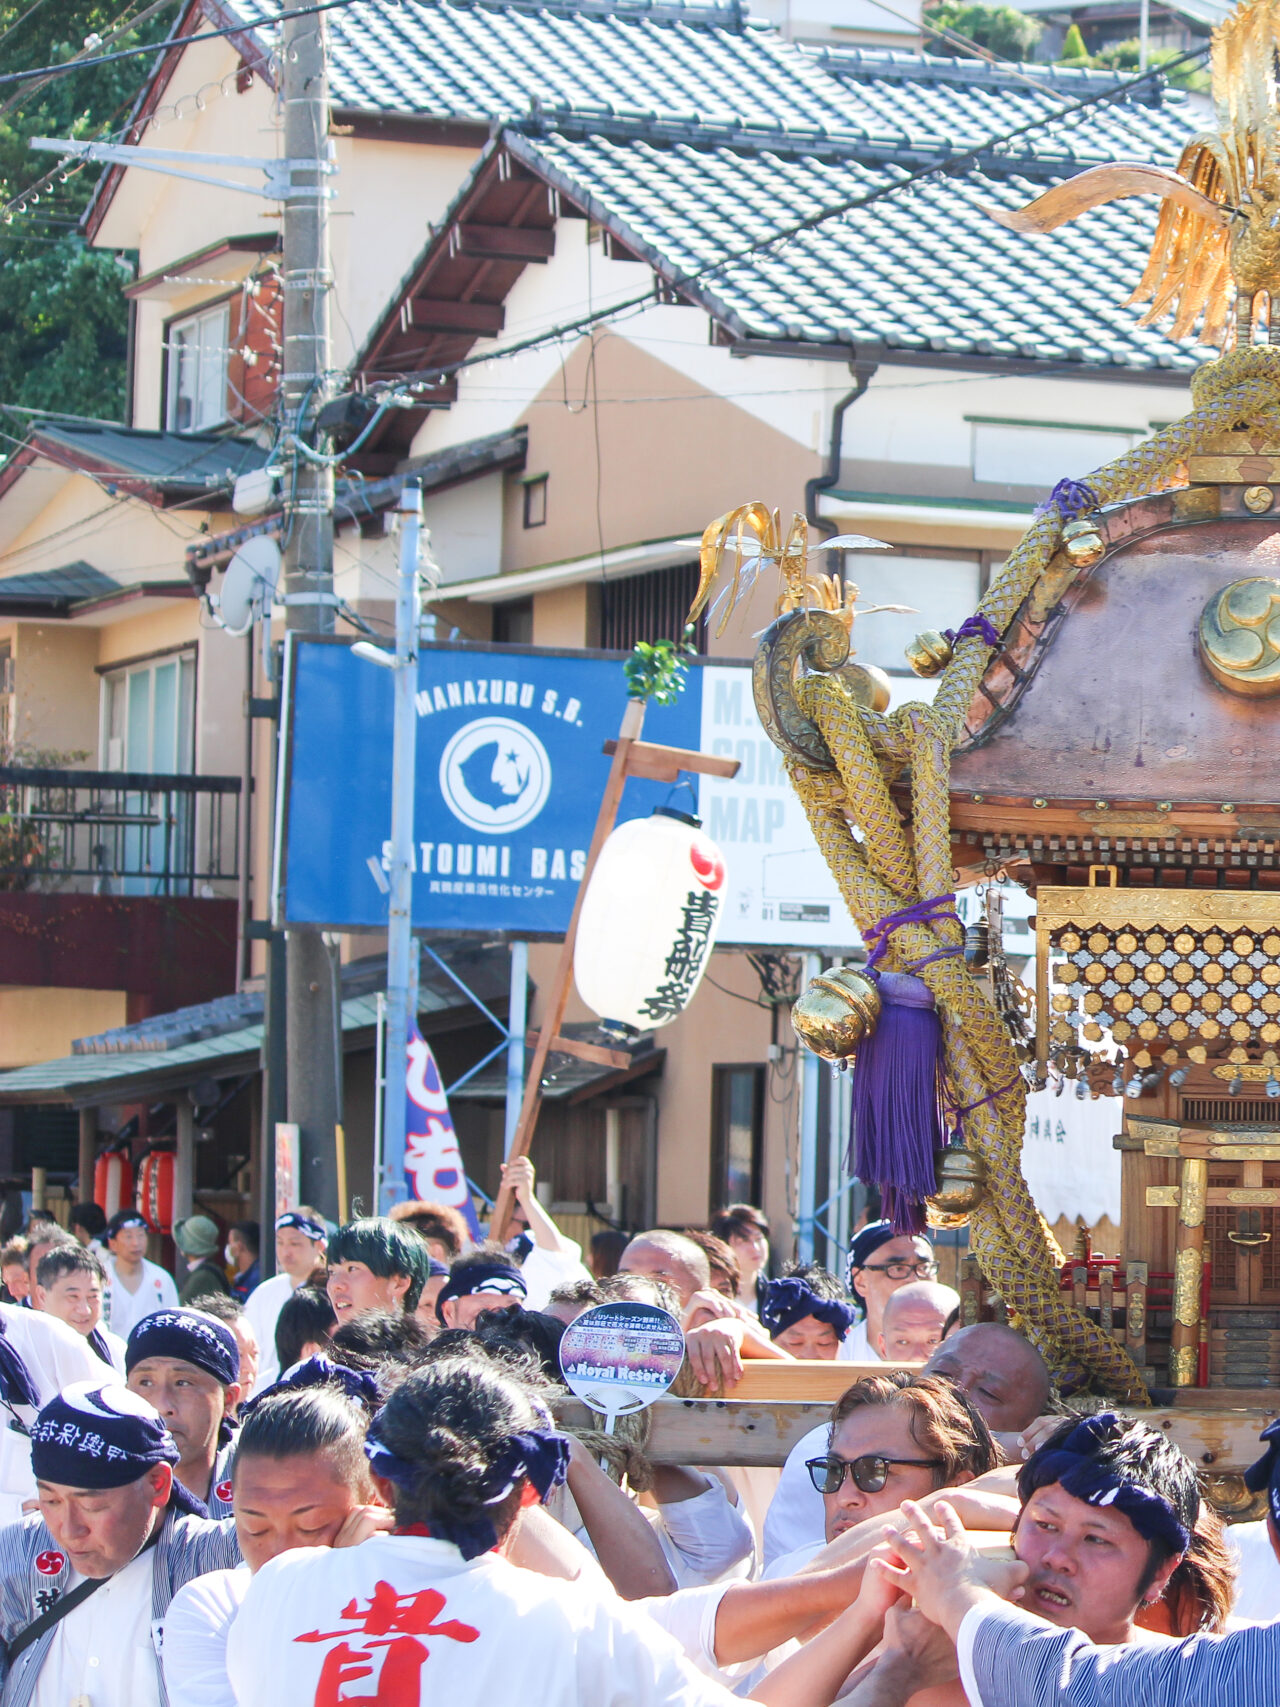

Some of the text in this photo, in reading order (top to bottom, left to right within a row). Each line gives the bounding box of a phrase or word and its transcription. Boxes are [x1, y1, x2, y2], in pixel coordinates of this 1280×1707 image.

[415, 679, 583, 727] MANAZURU S.B.
[713, 679, 762, 726] M.
[710, 796, 785, 844] MAP
[531, 848, 587, 880] BAS
[637, 890, 719, 1022] 貴船祭
[577, 1362, 615, 1379] Royal
[617, 1365, 667, 1383] Resort
